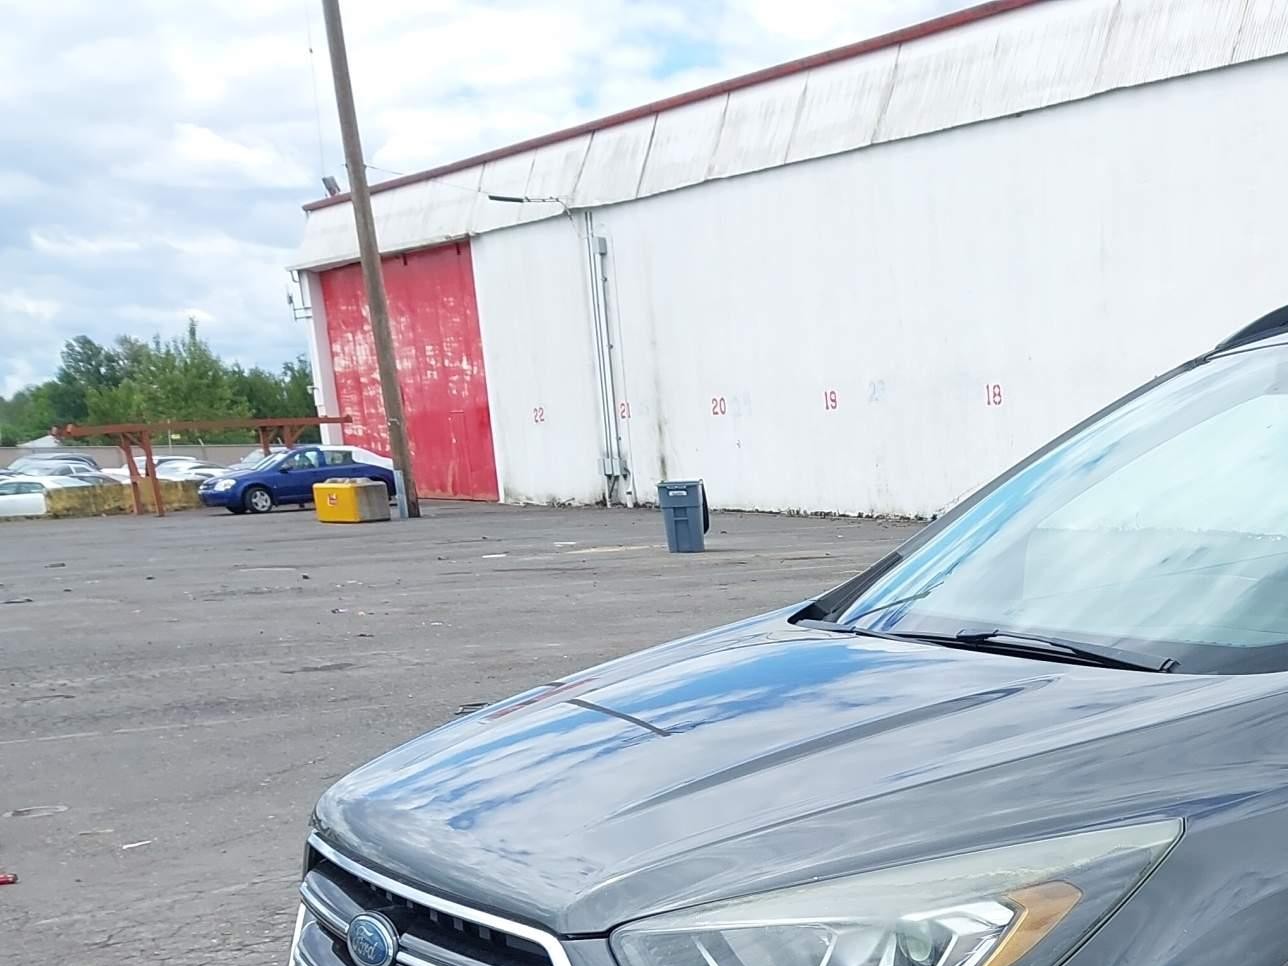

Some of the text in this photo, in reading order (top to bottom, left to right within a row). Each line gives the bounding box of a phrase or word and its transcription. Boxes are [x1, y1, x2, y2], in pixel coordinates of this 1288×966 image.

[823, 390, 839, 411] 19
[985, 383, 1003, 406] 18
[533, 406, 545, 423] 22
[619, 402, 632, 419] 21
[711, 396, 727, 416] 20
[352, 924, 380, 961] Ford
